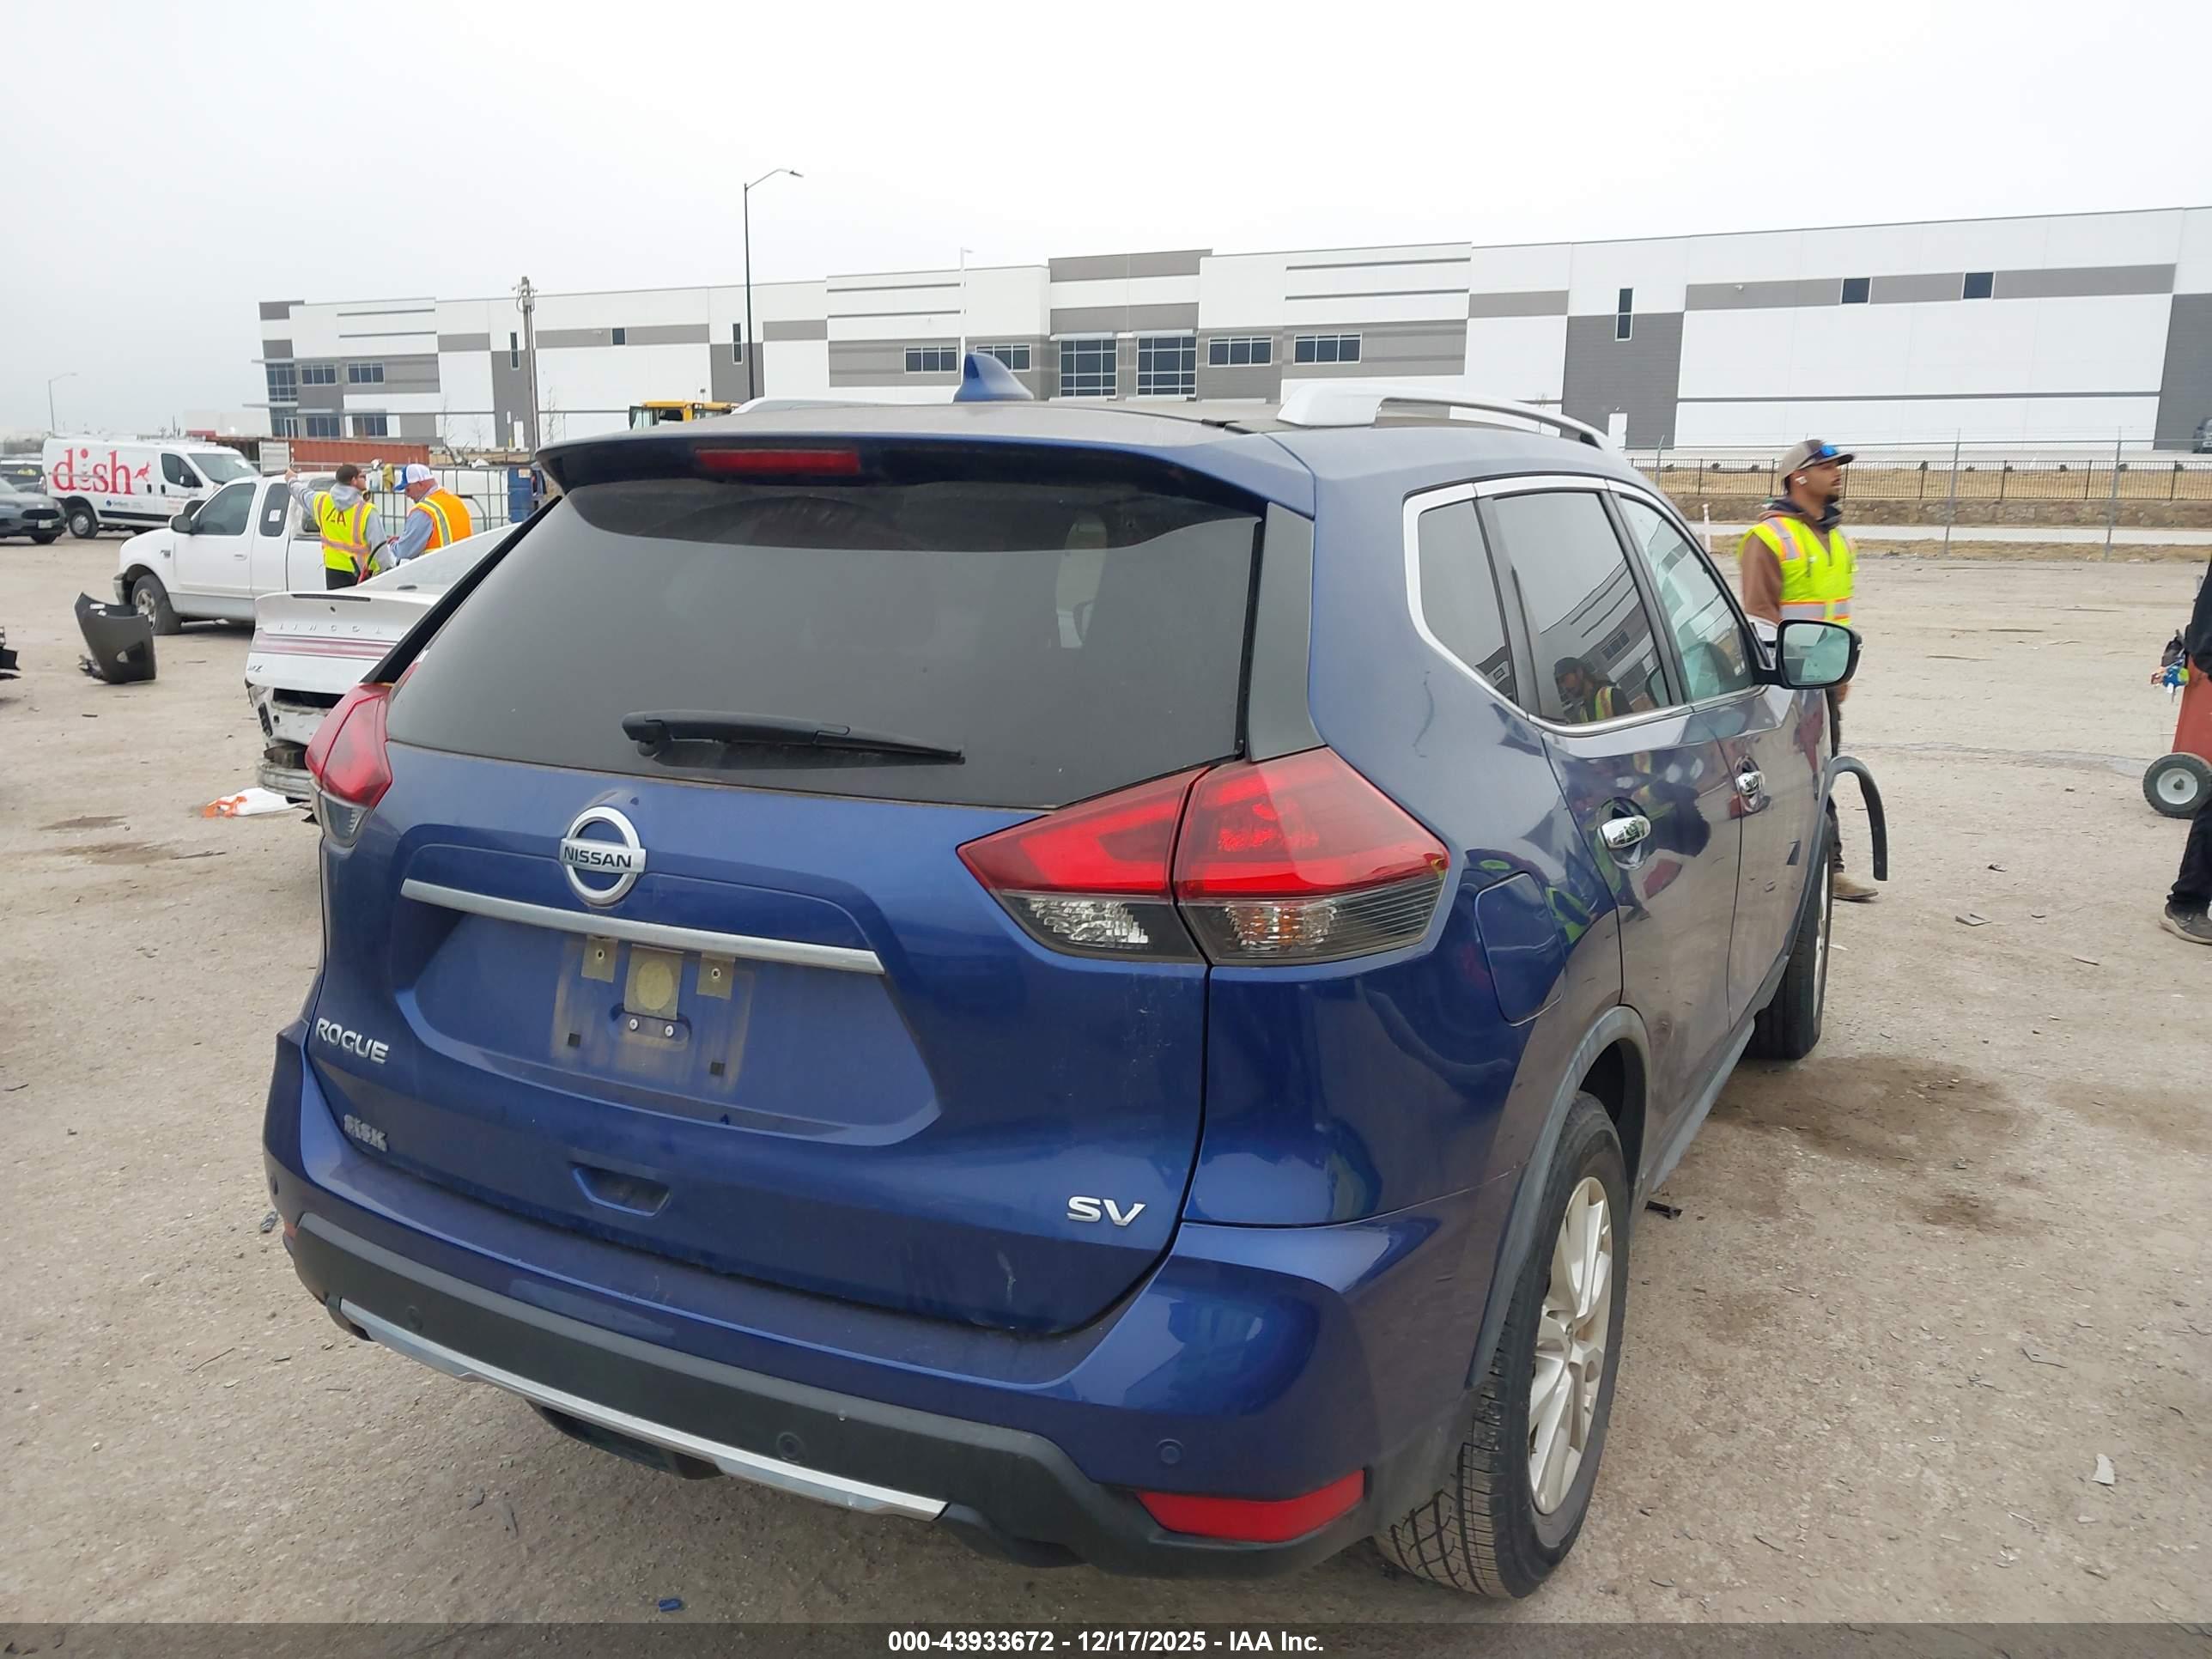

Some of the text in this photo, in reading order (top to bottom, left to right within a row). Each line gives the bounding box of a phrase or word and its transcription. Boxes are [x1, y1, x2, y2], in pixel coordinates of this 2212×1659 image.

[52, 447, 136, 495] dish
[564, 846, 632, 868] NISSAN
[315, 1017, 389, 1065] ROGUE
[1066, 1195, 1146, 1226] SV
